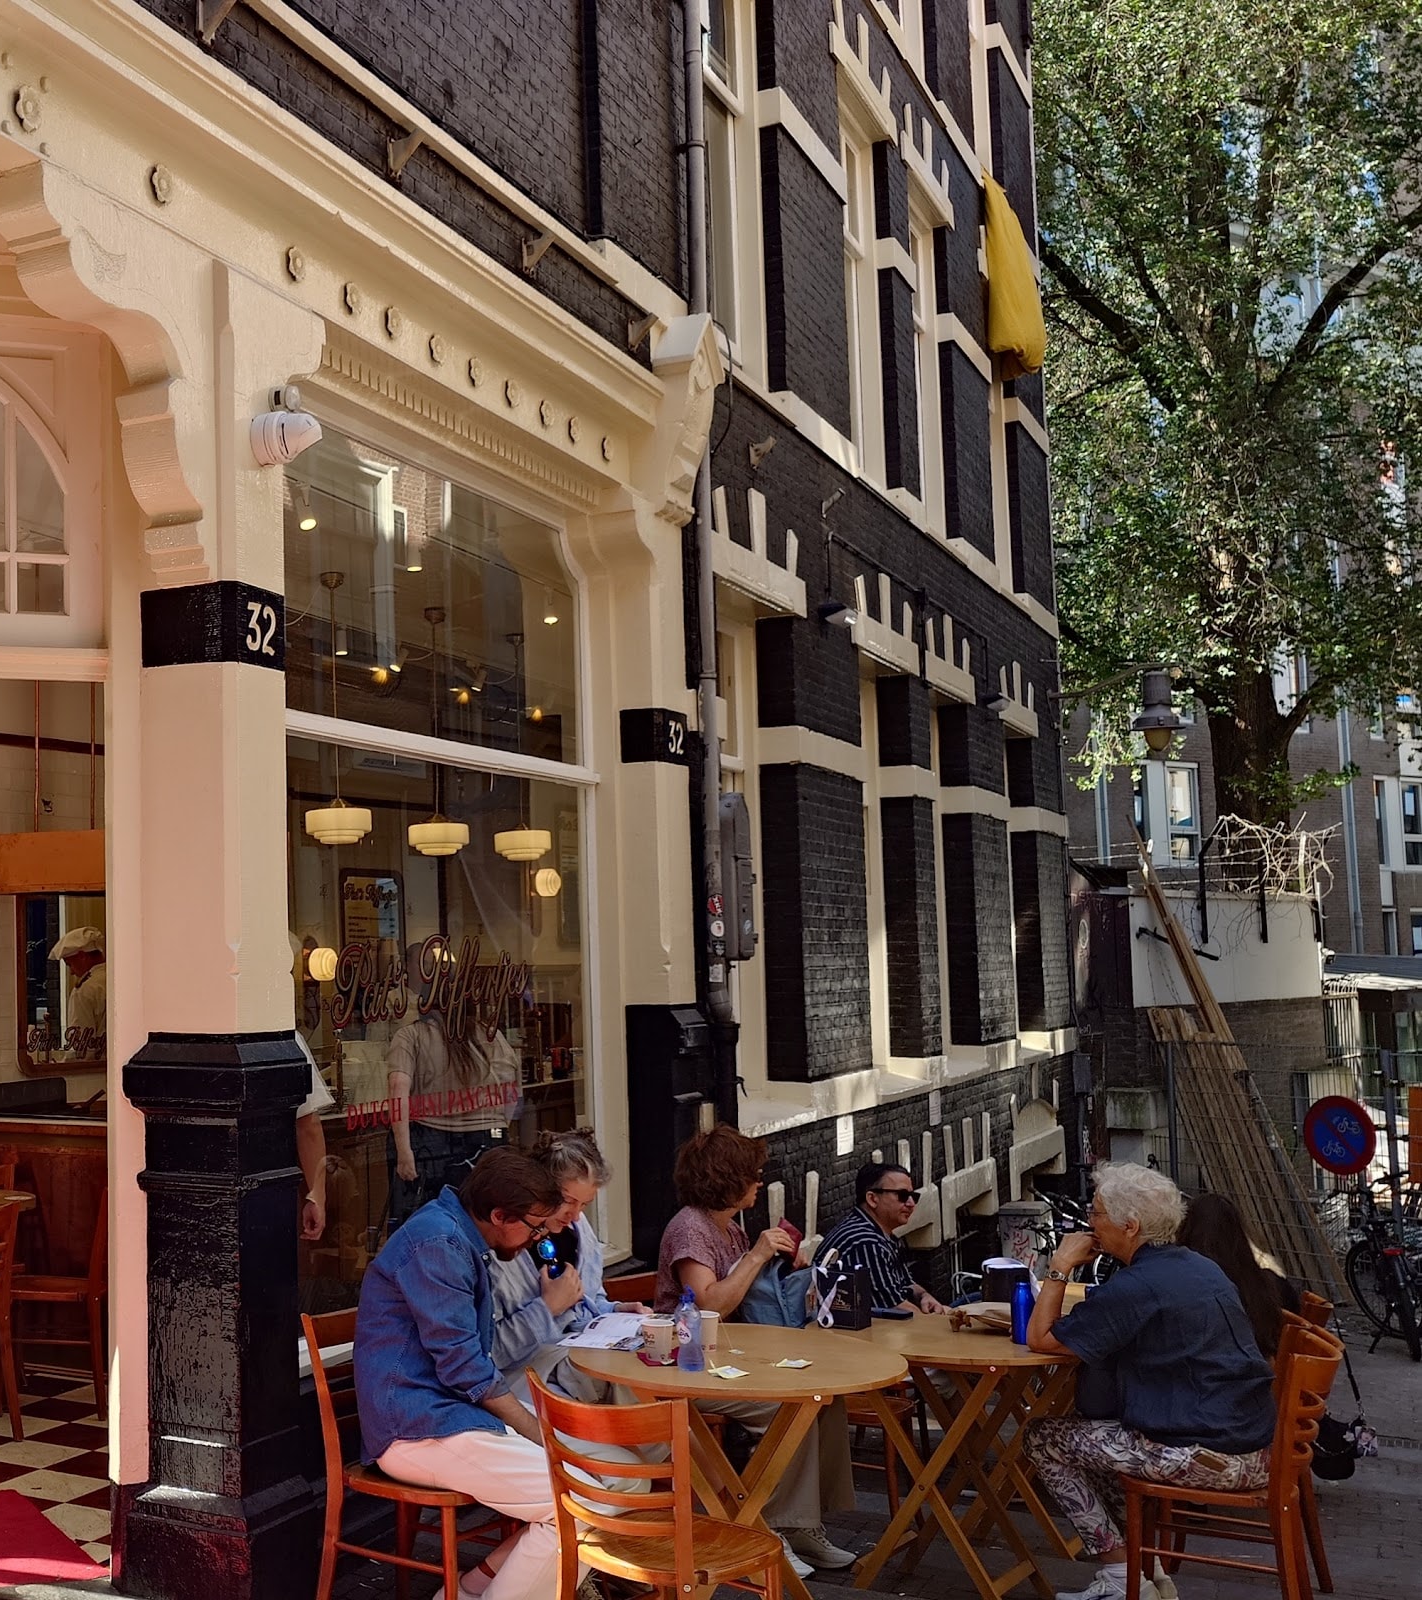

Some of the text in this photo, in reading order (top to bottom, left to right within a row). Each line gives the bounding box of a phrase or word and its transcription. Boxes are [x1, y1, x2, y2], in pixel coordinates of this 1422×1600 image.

[246, 601, 276, 656] 32
[668, 720, 684, 755] 32
[332, 933, 528, 1043] Pat's Poffertjes
[346, 1097, 403, 1131] DUTCH
[447, 1081, 519, 1114] PANCAKES
